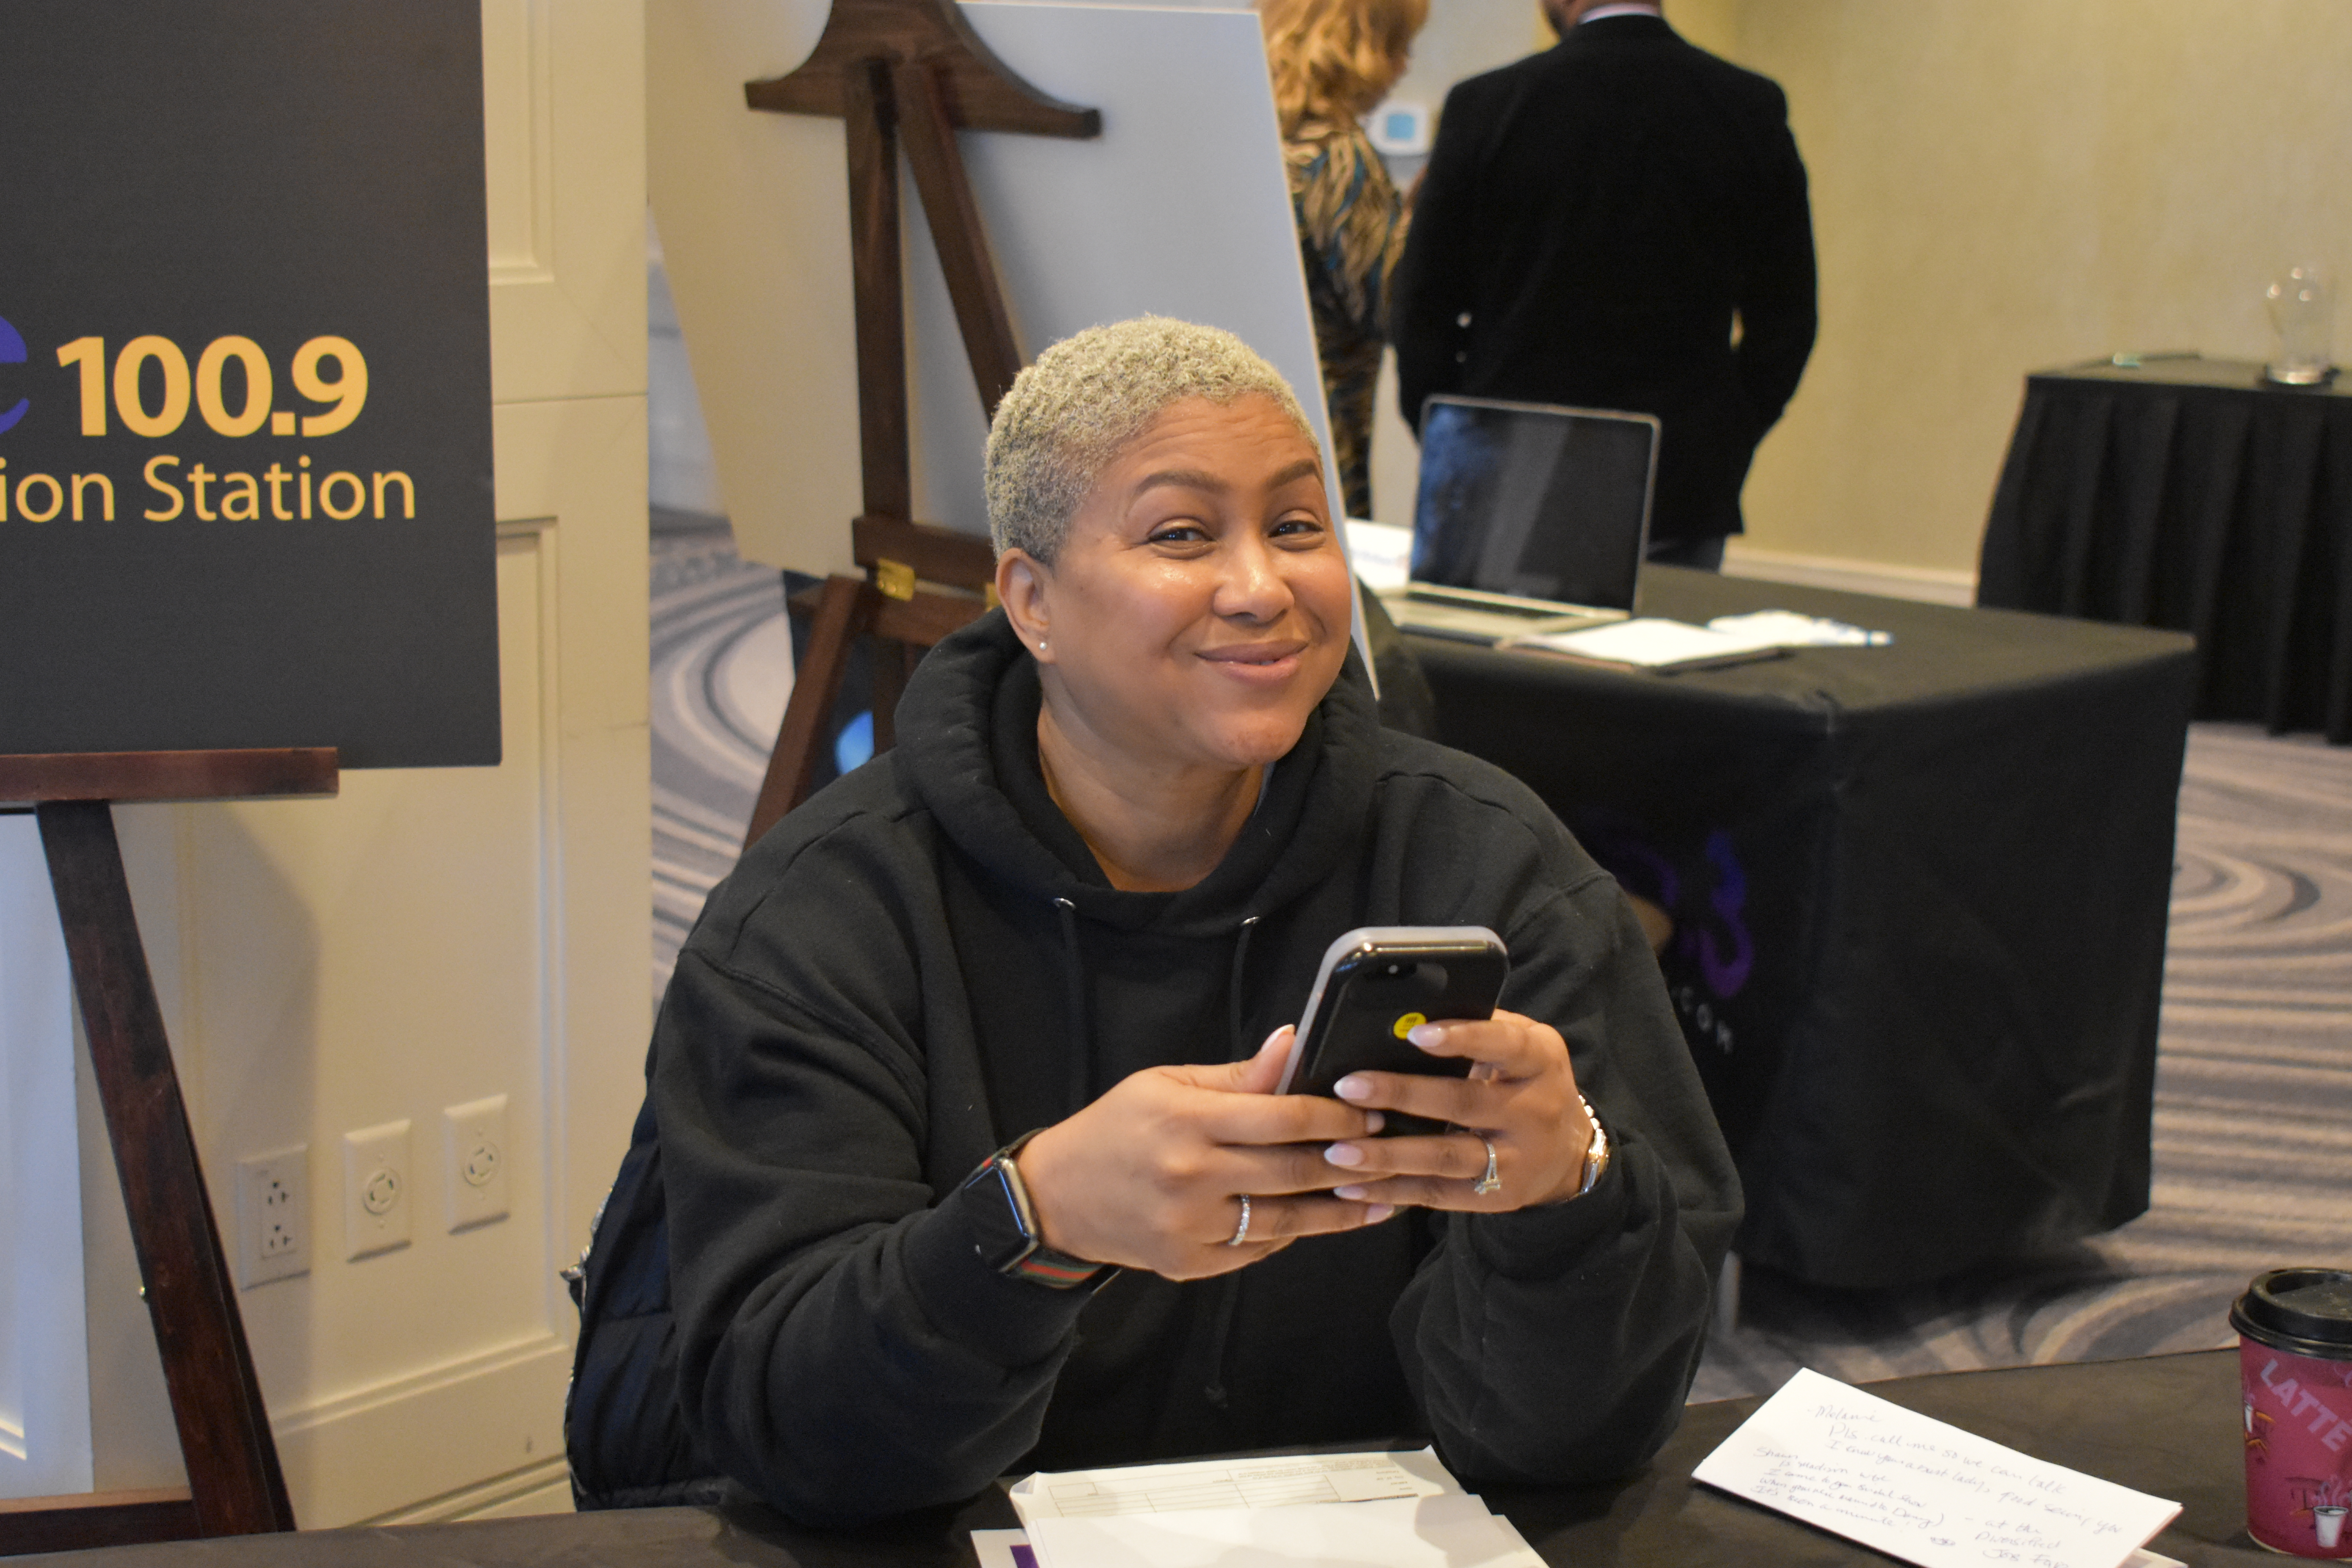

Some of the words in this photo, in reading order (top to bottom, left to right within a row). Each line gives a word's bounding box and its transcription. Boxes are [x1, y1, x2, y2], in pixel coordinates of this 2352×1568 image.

[56, 334, 368, 437] 100.9
[143, 455, 415, 522] Station
[2260, 1358, 2352, 1452] LATTE
[1870, 1434, 1902, 1447] call
[1906, 1442, 1936, 1452] me
[1963, 1456, 1982, 1468] we
[1991, 1465, 2023, 1481] can
